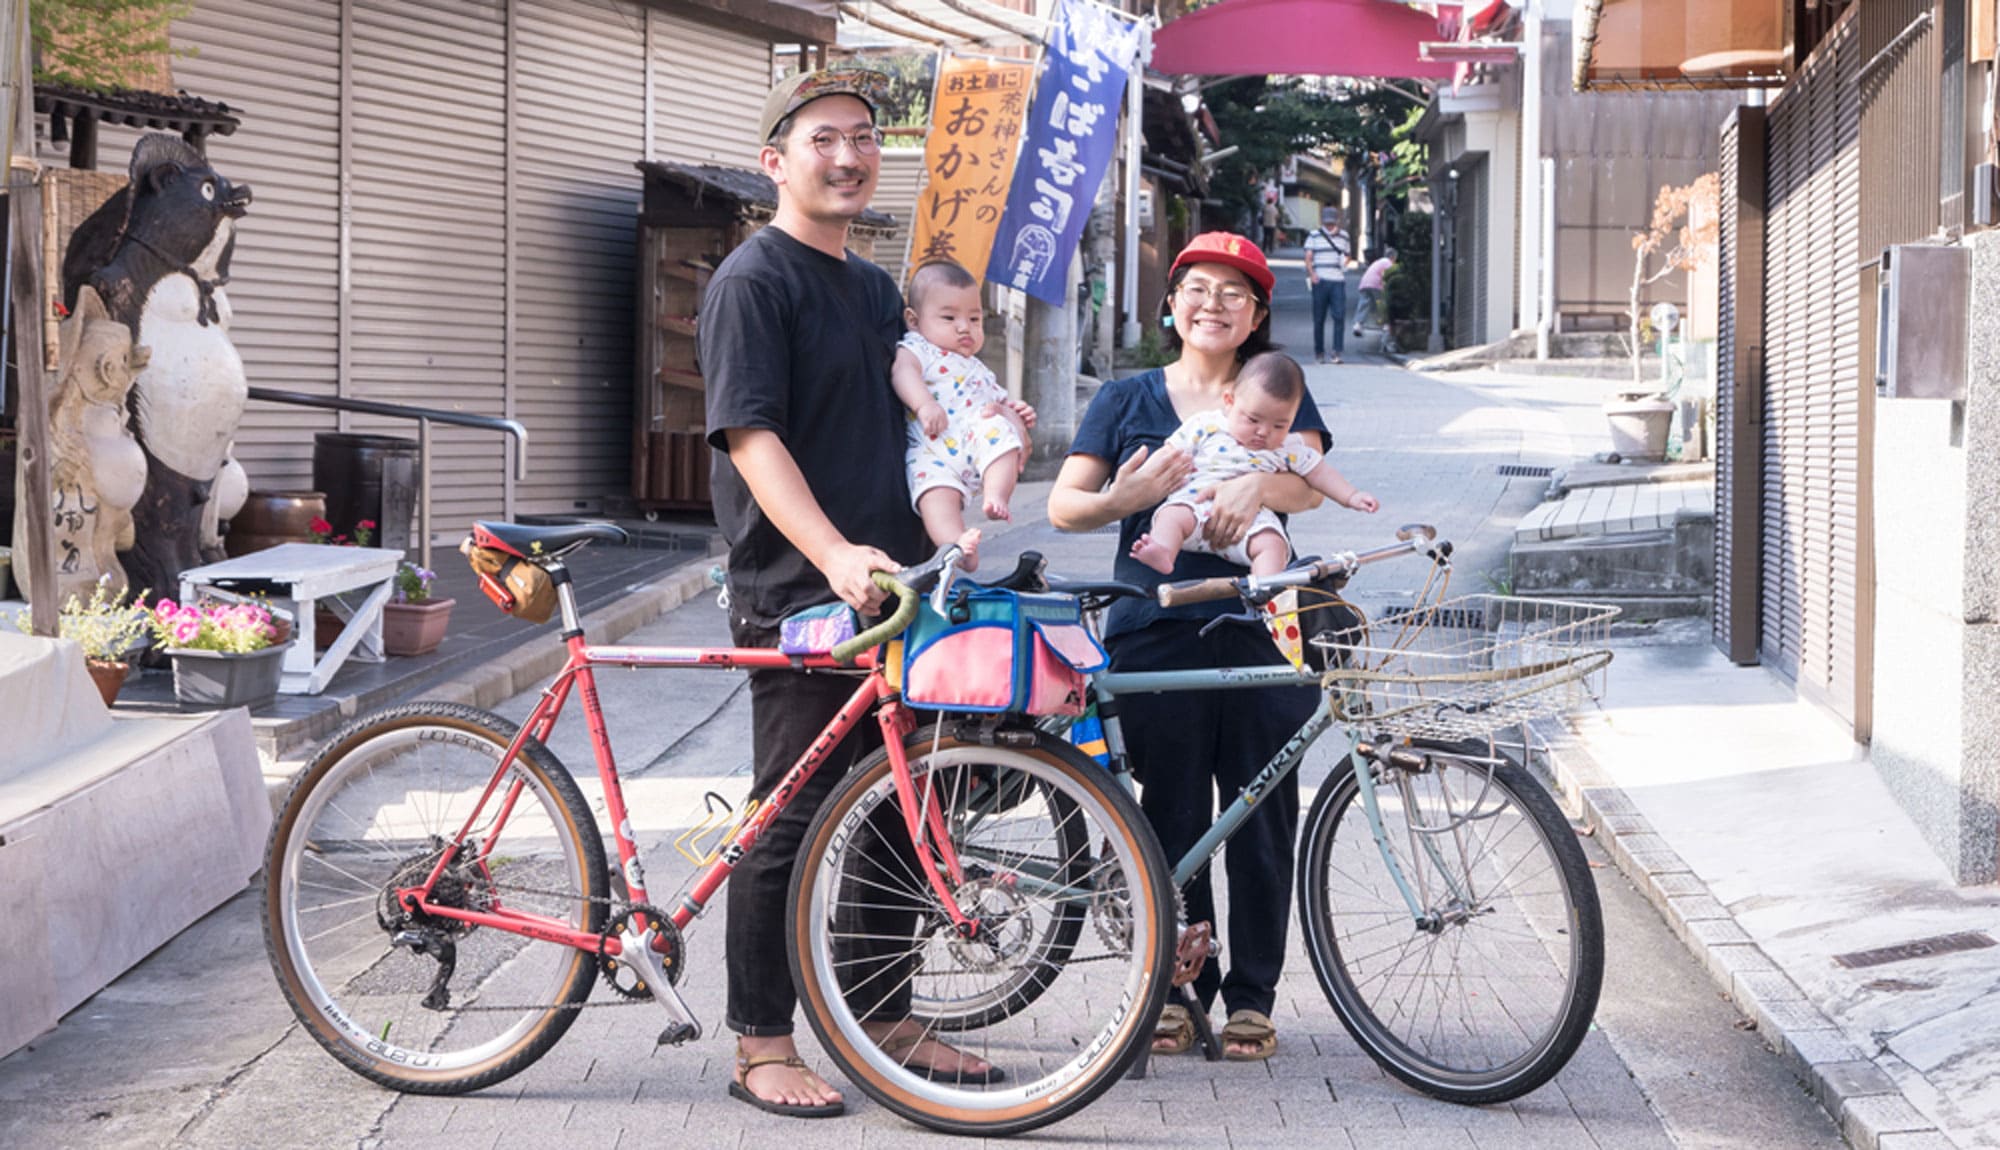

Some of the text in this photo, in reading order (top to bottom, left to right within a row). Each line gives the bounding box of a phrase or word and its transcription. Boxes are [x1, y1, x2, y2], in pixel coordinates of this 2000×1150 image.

[976, 90, 1023, 224] 荒神さんの
